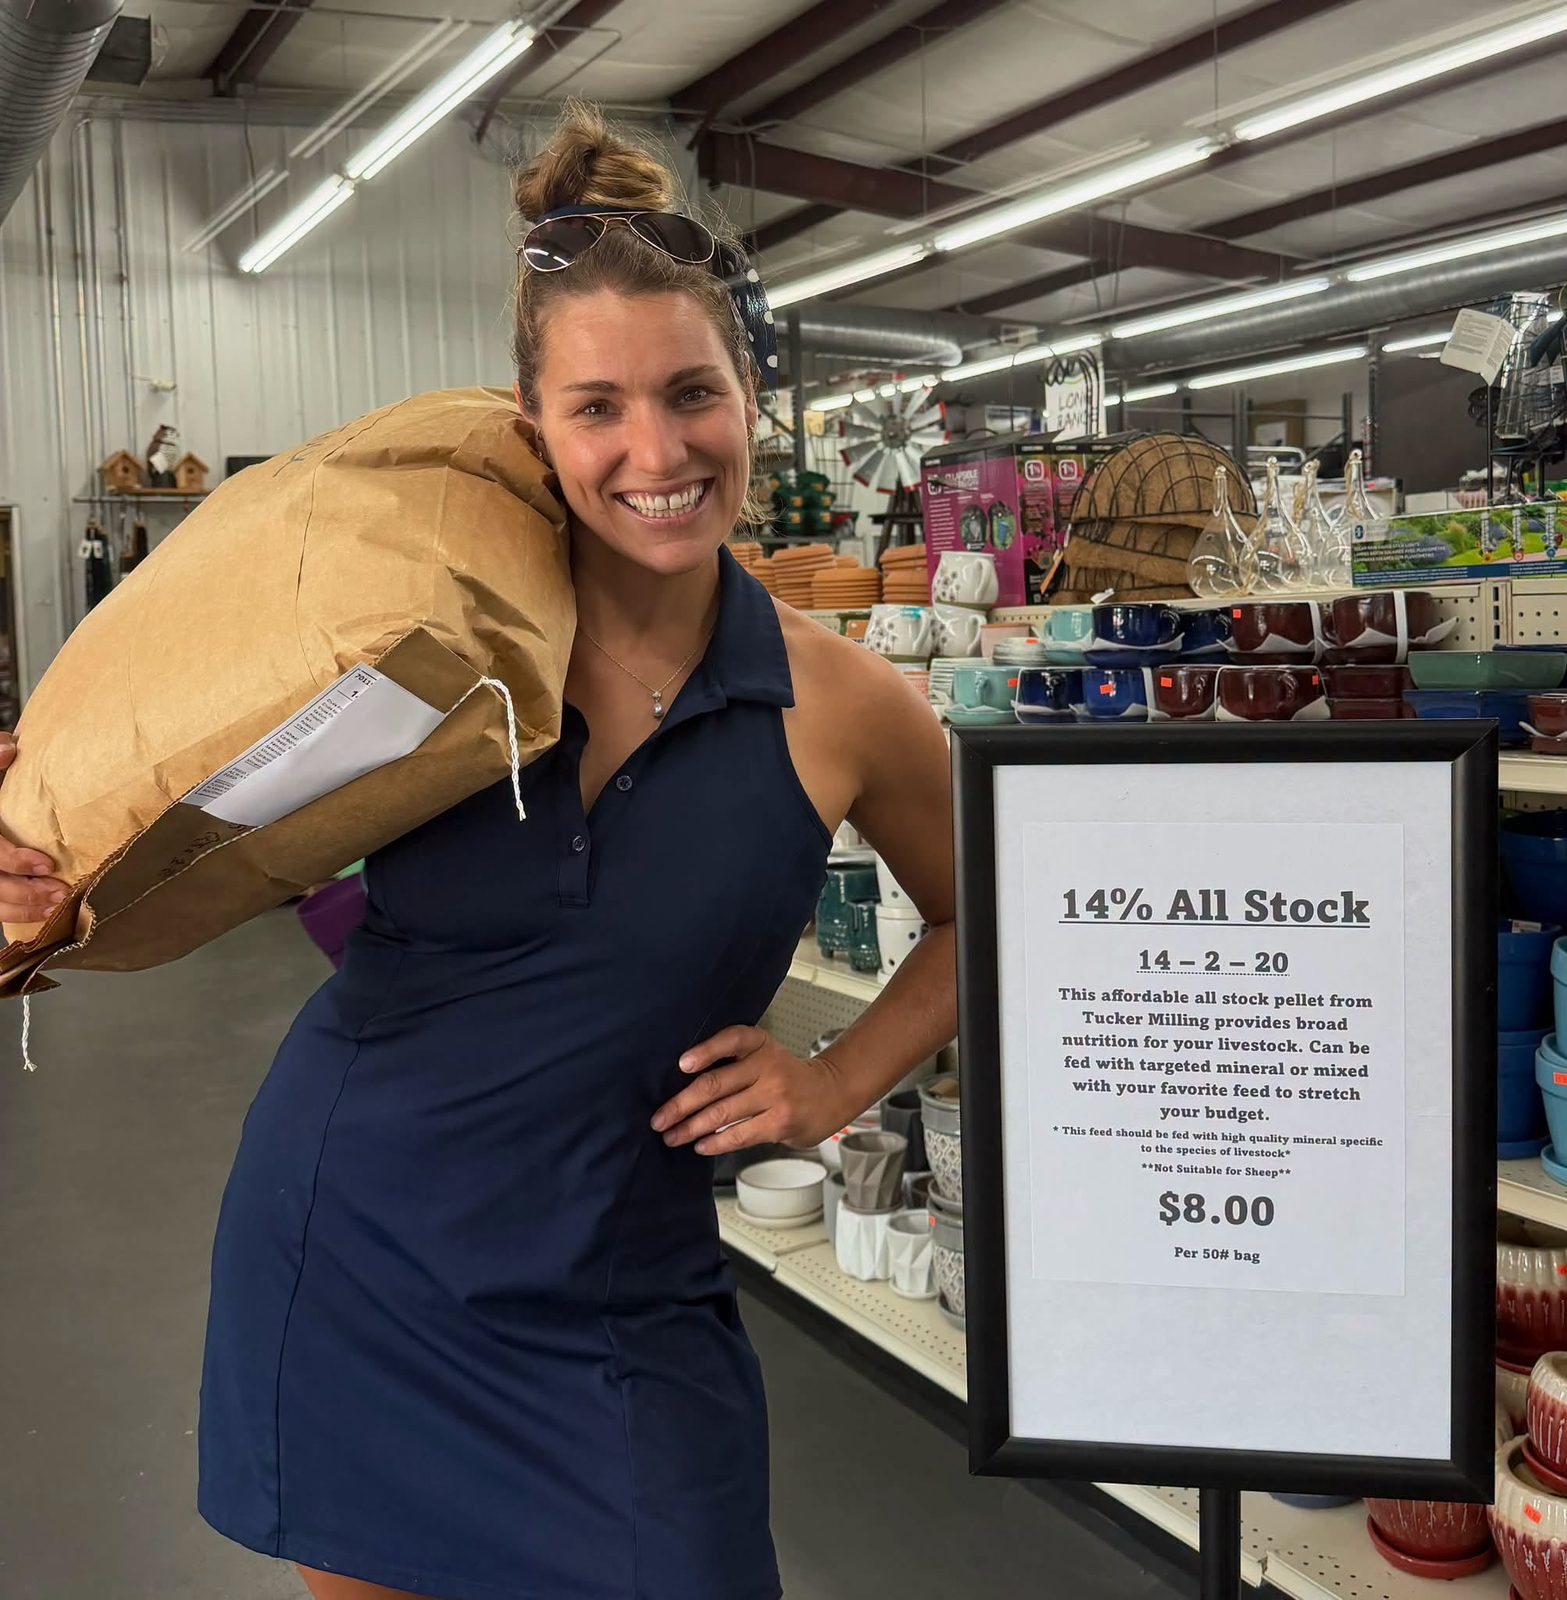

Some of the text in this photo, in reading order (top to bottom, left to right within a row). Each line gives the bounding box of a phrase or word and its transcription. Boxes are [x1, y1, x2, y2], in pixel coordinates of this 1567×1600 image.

[1063, 887, 1371, 924] 14% All Stock
[1139, 949, 1171, 970] 14
[1204, 950, 1221, 972] 2
[1254, 951, 1289, 974] 20
[1058, 987, 1373, 1010] This affordable all stock pellet from
[1081, 1011, 1349, 1031] Tucker Milling provides broad
[1061, 1033, 1370, 1055] nutrition for your livestock. Can be
[1063, 1055, 1369, 1078] fed with targeted mineral or mixed
[1072, 1078, 1361, 1101] with your favorite feed to stretch
[1159, 1105, 1270, 1124] your budget.
[1061, 1126, 1087, 1136] This
[1089, 1127, 1113, 1137] feed
[1115, 1128, 1153, 1138] should
[1155, 1129, 1169, 1139] be
[1171, 1130, 1190, 1140] fed
[1192, 1131, 1219, 1141] with
[1221, 1132, 1246, 1144] high
[1248, 1134, 1290, 1146] quality
[1292, 1135, 1337, 1145] mineral
[1340, 1136, 1383, 1148] specific
[1140, 1144, 1152, 1153] to
[1154, 1144, 1173, 1154] the
[1176, 1146, 1217, 1157] species
[1219, 1146, 1232, 1156] of
[1176, 1164, 1223, 1175] Suitable
[1225, 1166, 1243, 1176] for
[1159, 1190, 1275, 1227] $8.00
[1174, 1246, 1261, 1265] Per 50# bag
